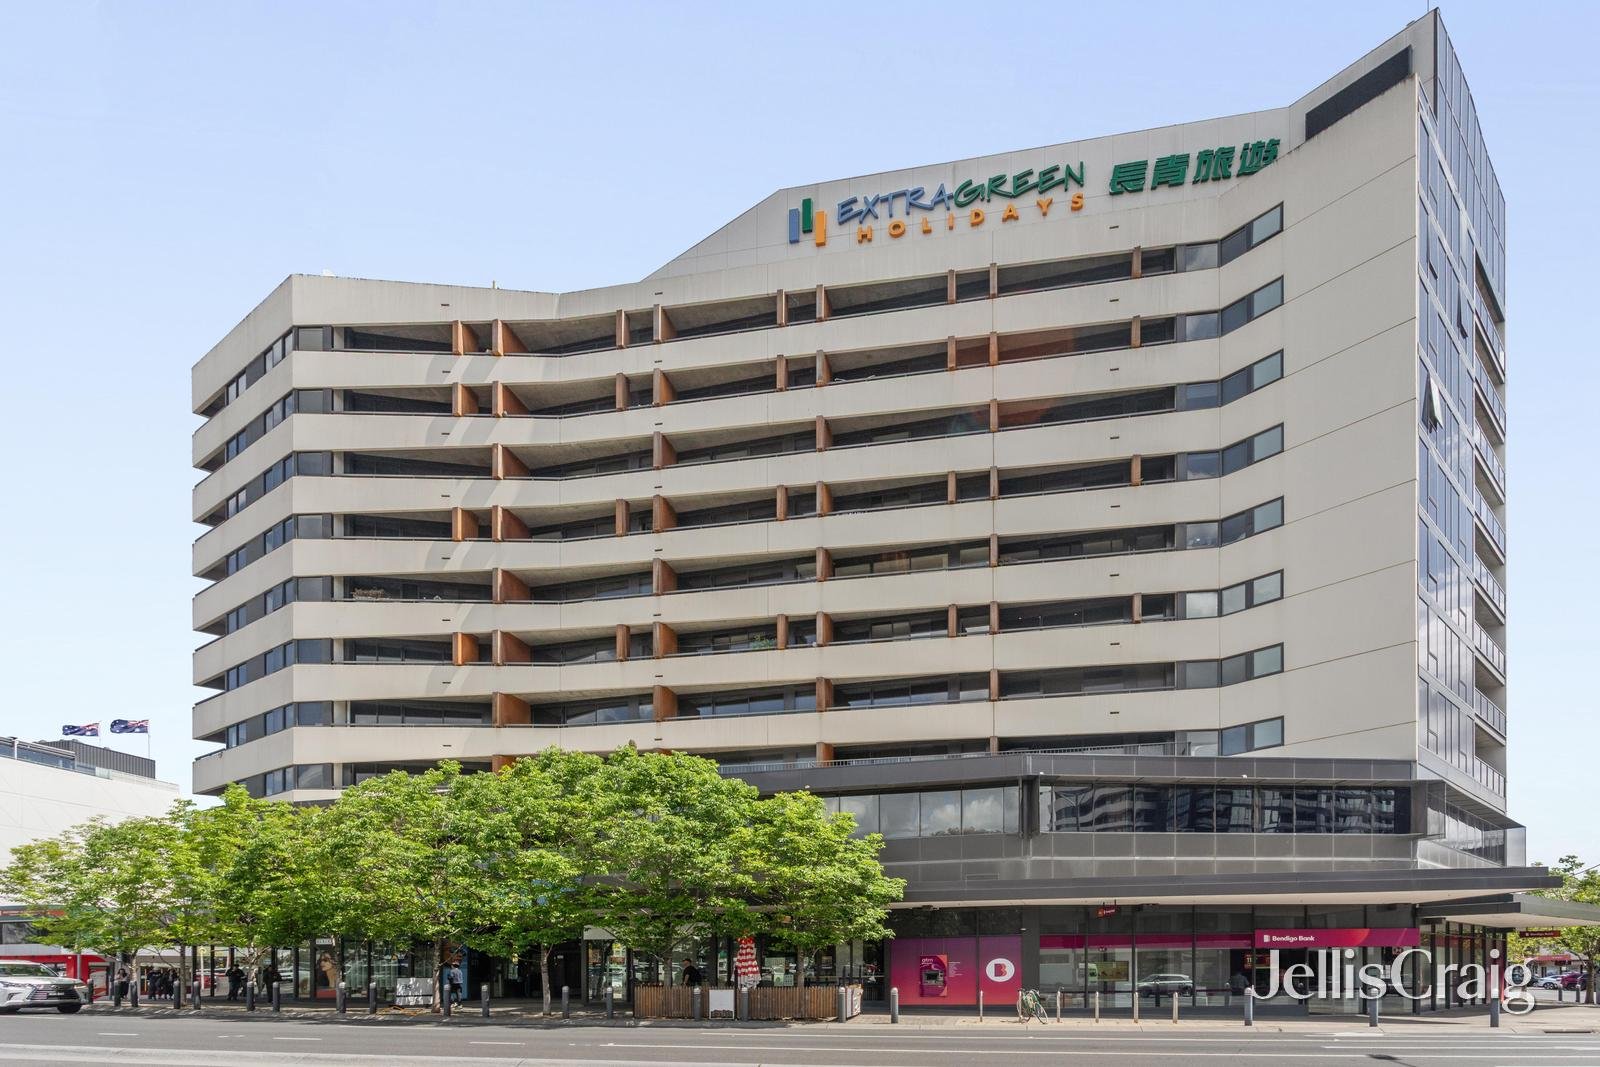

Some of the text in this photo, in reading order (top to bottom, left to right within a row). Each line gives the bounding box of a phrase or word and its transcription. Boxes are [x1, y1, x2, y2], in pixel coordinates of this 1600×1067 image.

[1109, 138, 1281, 196] 長青旅遊
[857, 193, 1084, 243] HOLIDAYS
[1272, 935, 1298, 943] Bendigo
